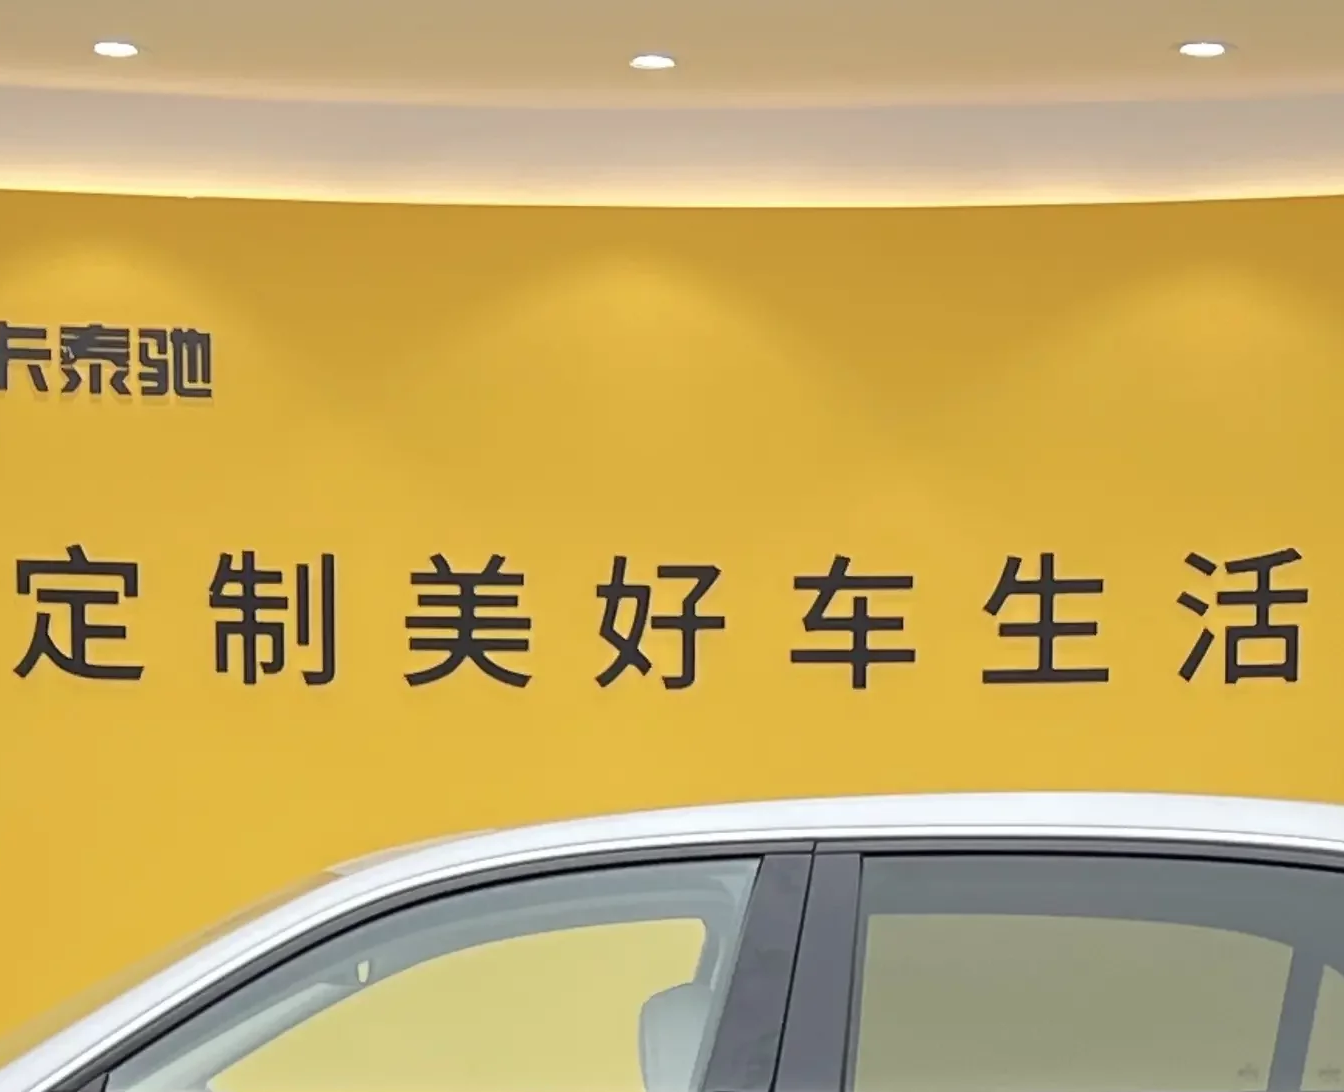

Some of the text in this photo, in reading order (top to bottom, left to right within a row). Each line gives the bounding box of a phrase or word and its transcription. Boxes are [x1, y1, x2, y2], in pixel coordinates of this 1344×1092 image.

[14, 545, 1308, 690] 定制美好车生活
